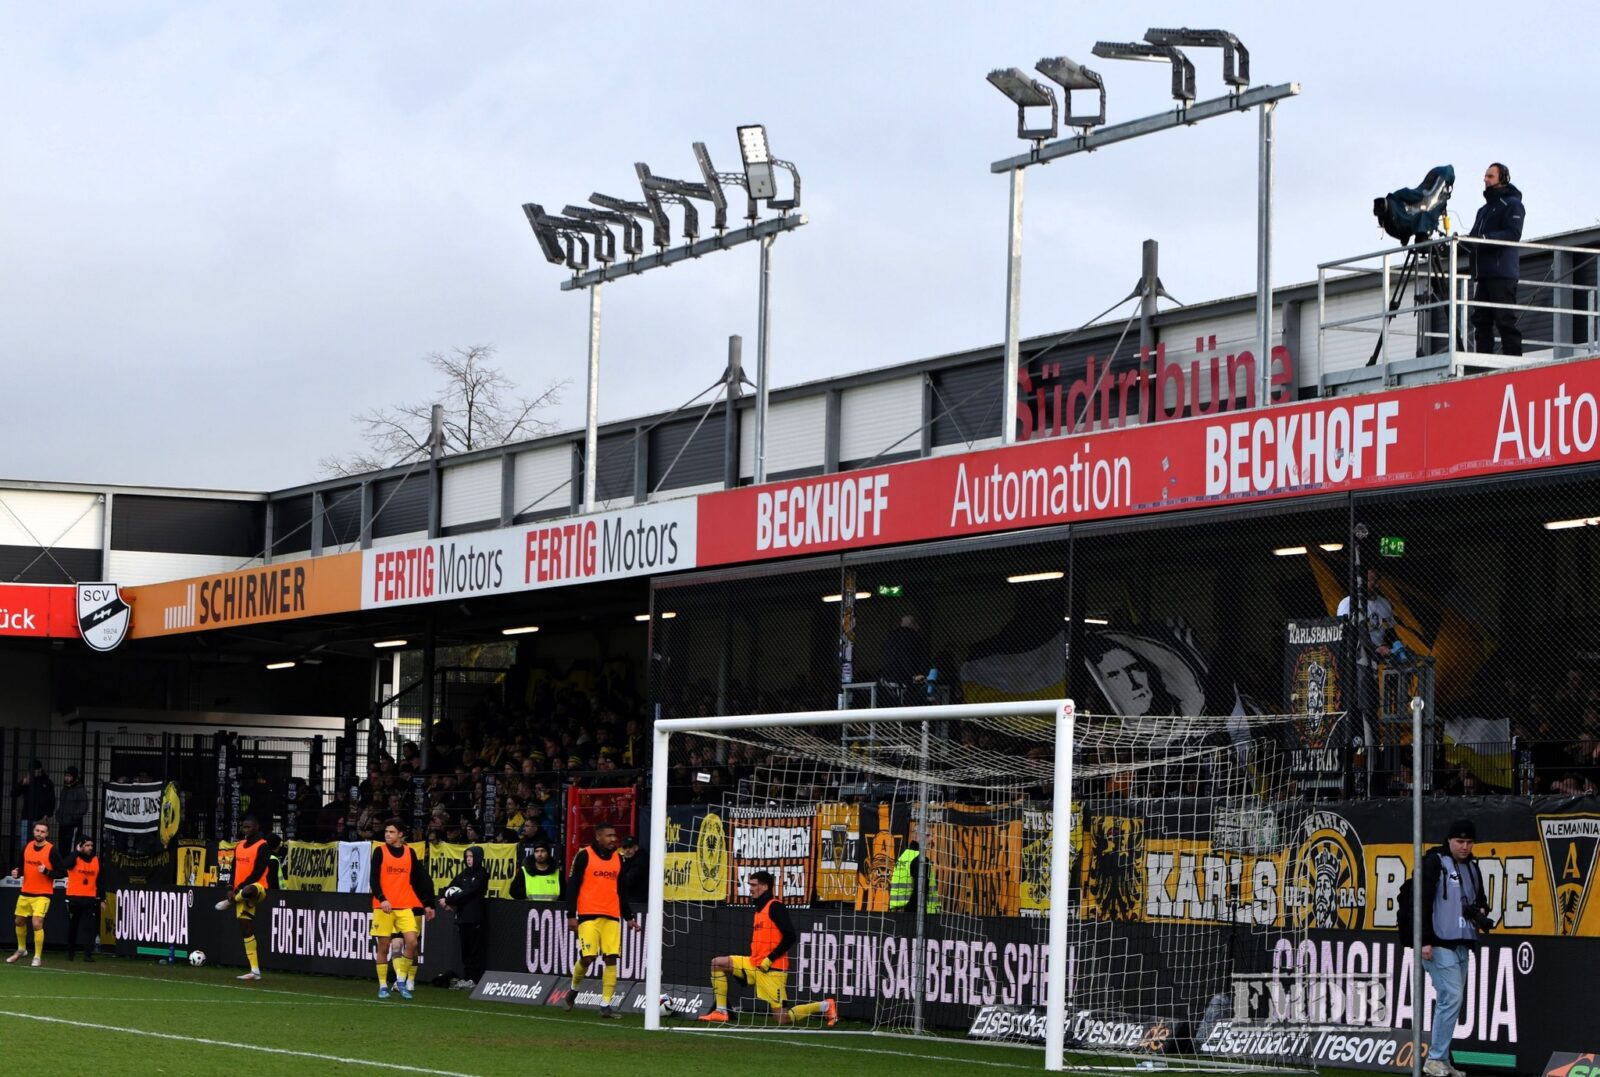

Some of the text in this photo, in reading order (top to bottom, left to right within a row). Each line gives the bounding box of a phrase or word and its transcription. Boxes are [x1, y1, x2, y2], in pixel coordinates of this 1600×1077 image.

[1015, 335, 1293, 441] Südtribüne
[1205, 400, 1400, 495] BECKHOFF
[756, 473, 889, 551] BECKHOFF
[950, 443, 1132, 527] Automation
[374, 543, 503, 602] FERTIG Motors
[524, 517, 678, 584] FERTIG Motors
[83, 590, 110, 601] SCV
[199, 566, 306, 624] SCHIRMER
[1288, 622, 1344, 644] KARLSBANDE
[1304, 812, 1349, 838] KARLS
[1545, 822, 1600, 836] ALEMANNIA
[271, 900, 294, 954] FÜR
[296, 908, 316, 957] EIN
[317, 910, 377, 962] SAUBERE
[482, 979, 543, 1000] wa-strom.de
[798, 922, 838, 994] FÜR
[842, 934, 879, 998] EIN
[1002, 942, 1075, 1007] SPIE!
[968, 1006, 1071, 1039] Eisenbah
